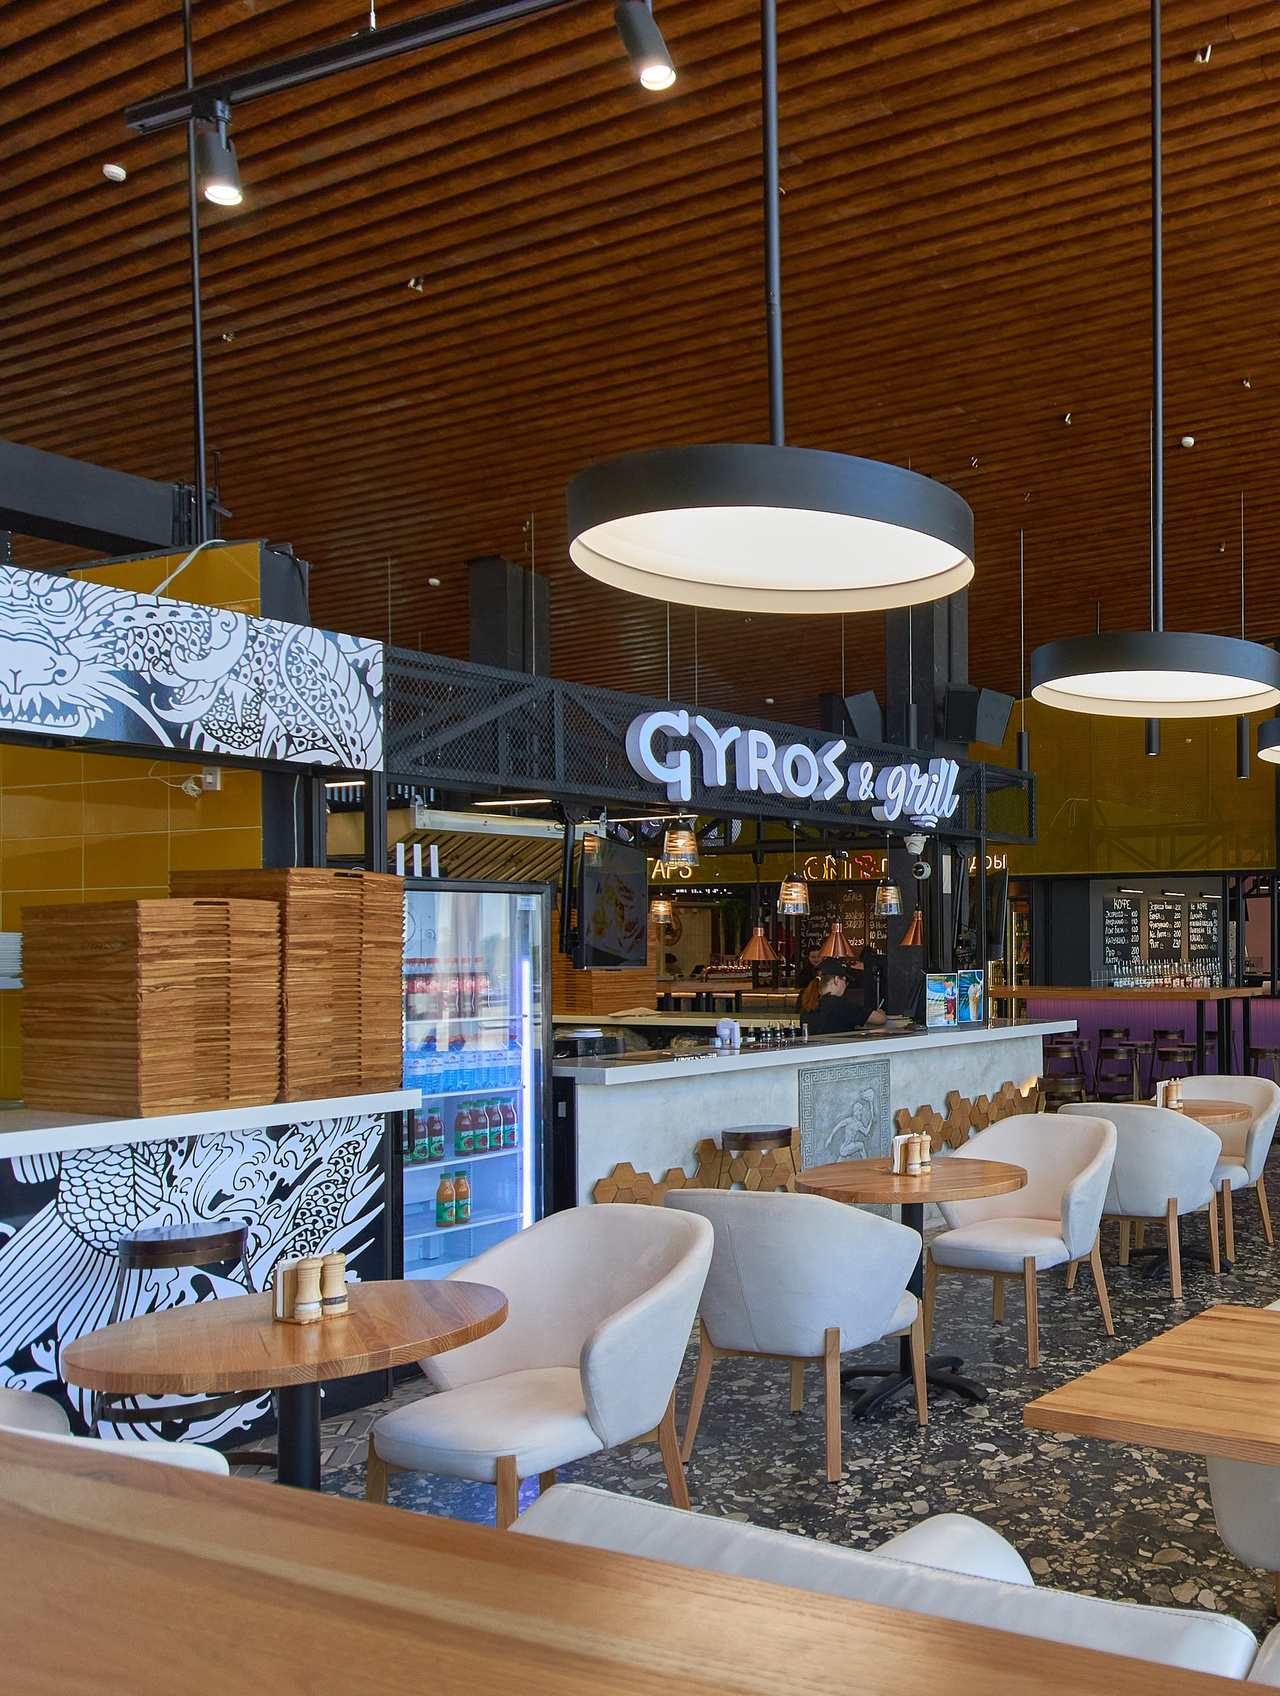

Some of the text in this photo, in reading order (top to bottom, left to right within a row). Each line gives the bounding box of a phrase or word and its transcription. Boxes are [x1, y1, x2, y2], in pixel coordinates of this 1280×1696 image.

[626, 709, 960, 822] GYROS & grill
[1113, 898, 1132, 910] КОФЕ
